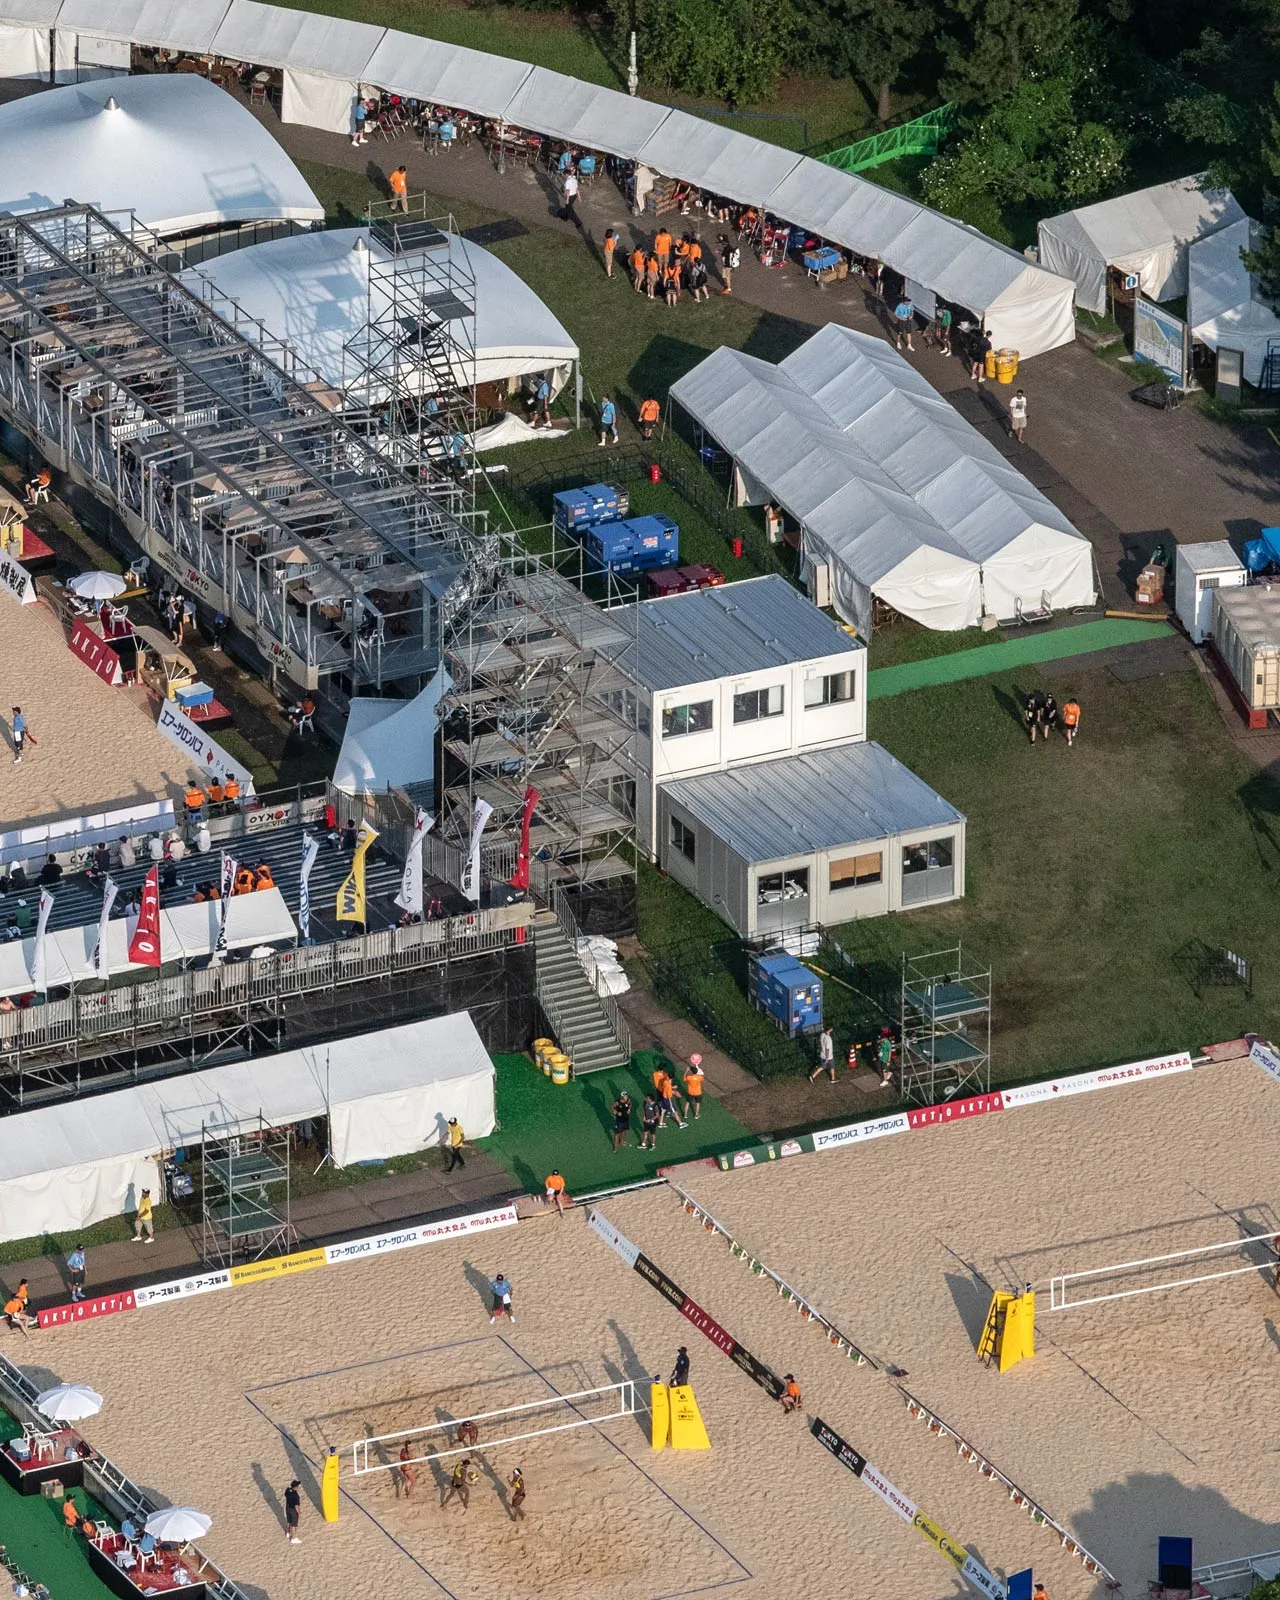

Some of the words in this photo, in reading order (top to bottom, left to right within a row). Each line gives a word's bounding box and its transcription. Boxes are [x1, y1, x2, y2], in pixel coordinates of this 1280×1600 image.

[186, 568, 210, 592] TOKYO
[72, 631, 113, 673] AKTIO
[270, 642, 292, 665] TOKYO
[160, 710, 204, 757] エアーサロンパス
[215, 761, 245, 792] PASA
[1062, 1078, 1095, 1090] PASONA
[1015, 1088, 1047, 1100] PASONA
[960, 1096, 1000, 1114] AKTIO
[912, 1106, 952, 1125] AKTIO
[863, 1118, 905, 1135] エアーサロンパス
[817, 1128, 859, 1146] エアーサロンパス
[376, 1232, 417, 1249] エアーサロンパス
[330, 1242, 372, 1259] エアーサロンパス
[91, 1295, 132, 1313] AKTIO
[43, 1306, 84, 1324] AKTIO
[684, 1303, 708, 1327] AKTIO
[709, 1325, 733, 1349] AKTIO
[820, 1426, 838, 1446] TOKYO
[841, 1445, 859, 1464] TOKYO
